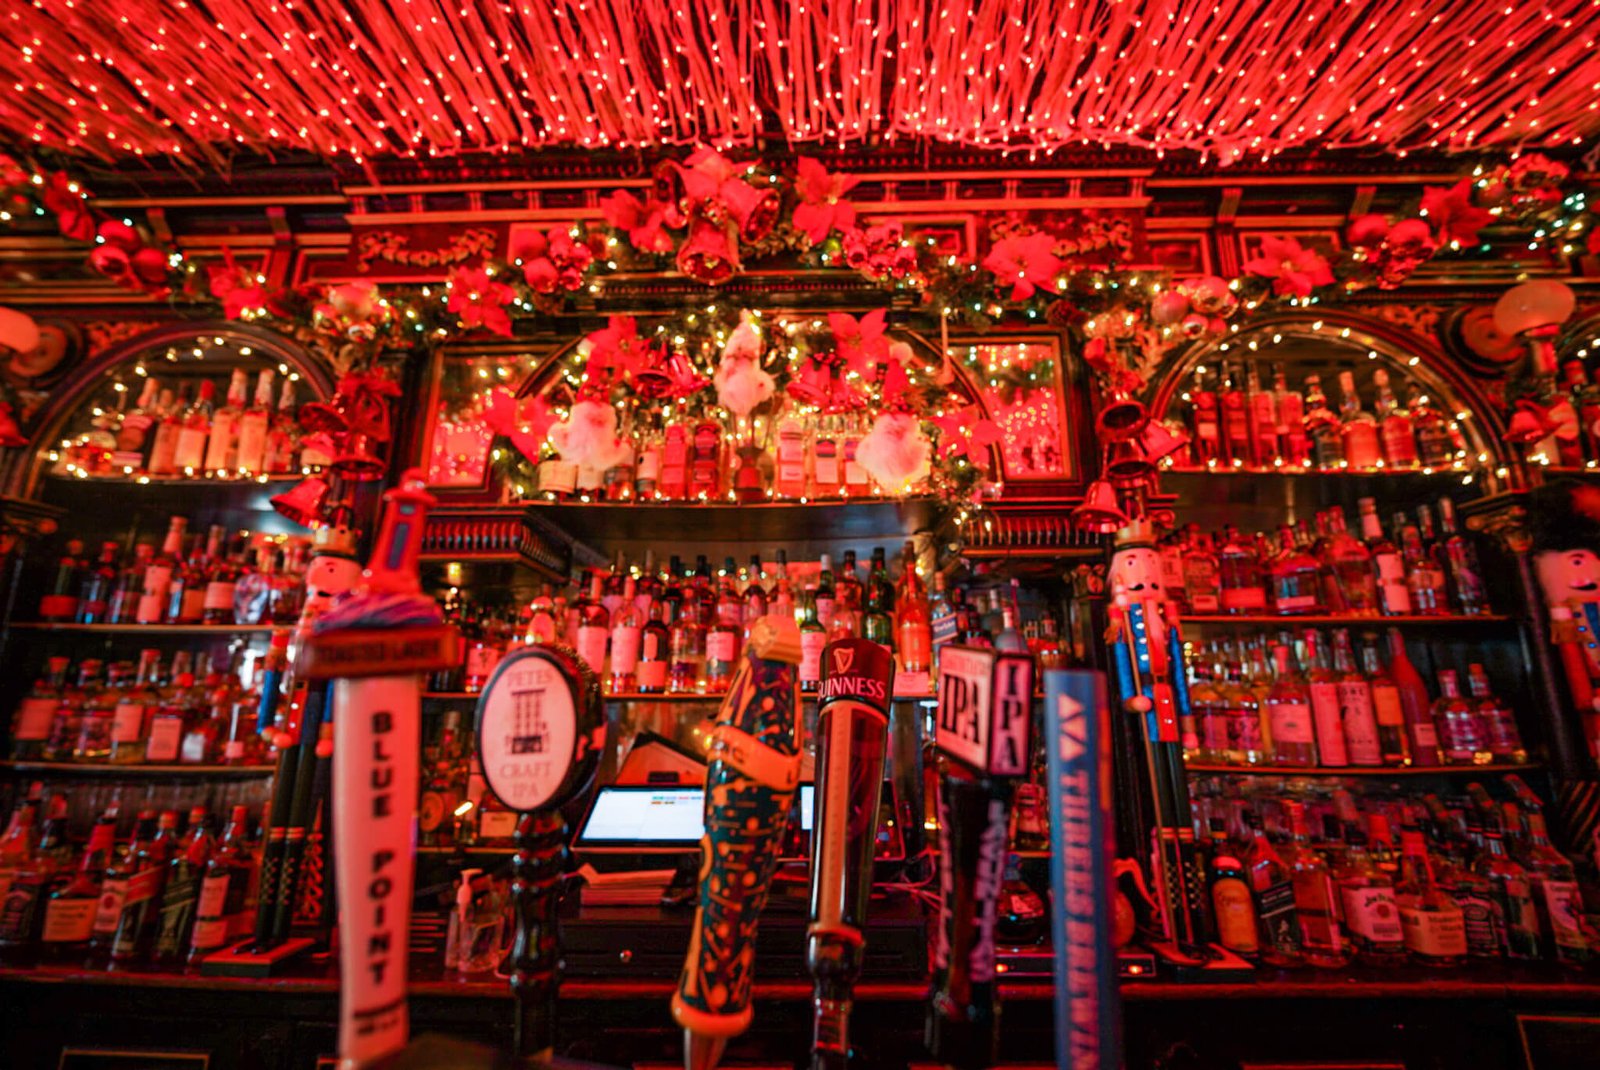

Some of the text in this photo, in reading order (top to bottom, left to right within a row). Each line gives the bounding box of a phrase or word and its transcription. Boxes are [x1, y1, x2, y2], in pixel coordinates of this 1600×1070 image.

[507, 669, 552, 687] PETES
[818, 677, 885, 699] UINNESS
[941, 673, 980, 744] IPA
[501, 761, 552, 779] CRAFT
[512, 782, 540, 798] IPA
[368, 710, 395, 986] BLUE POINT
